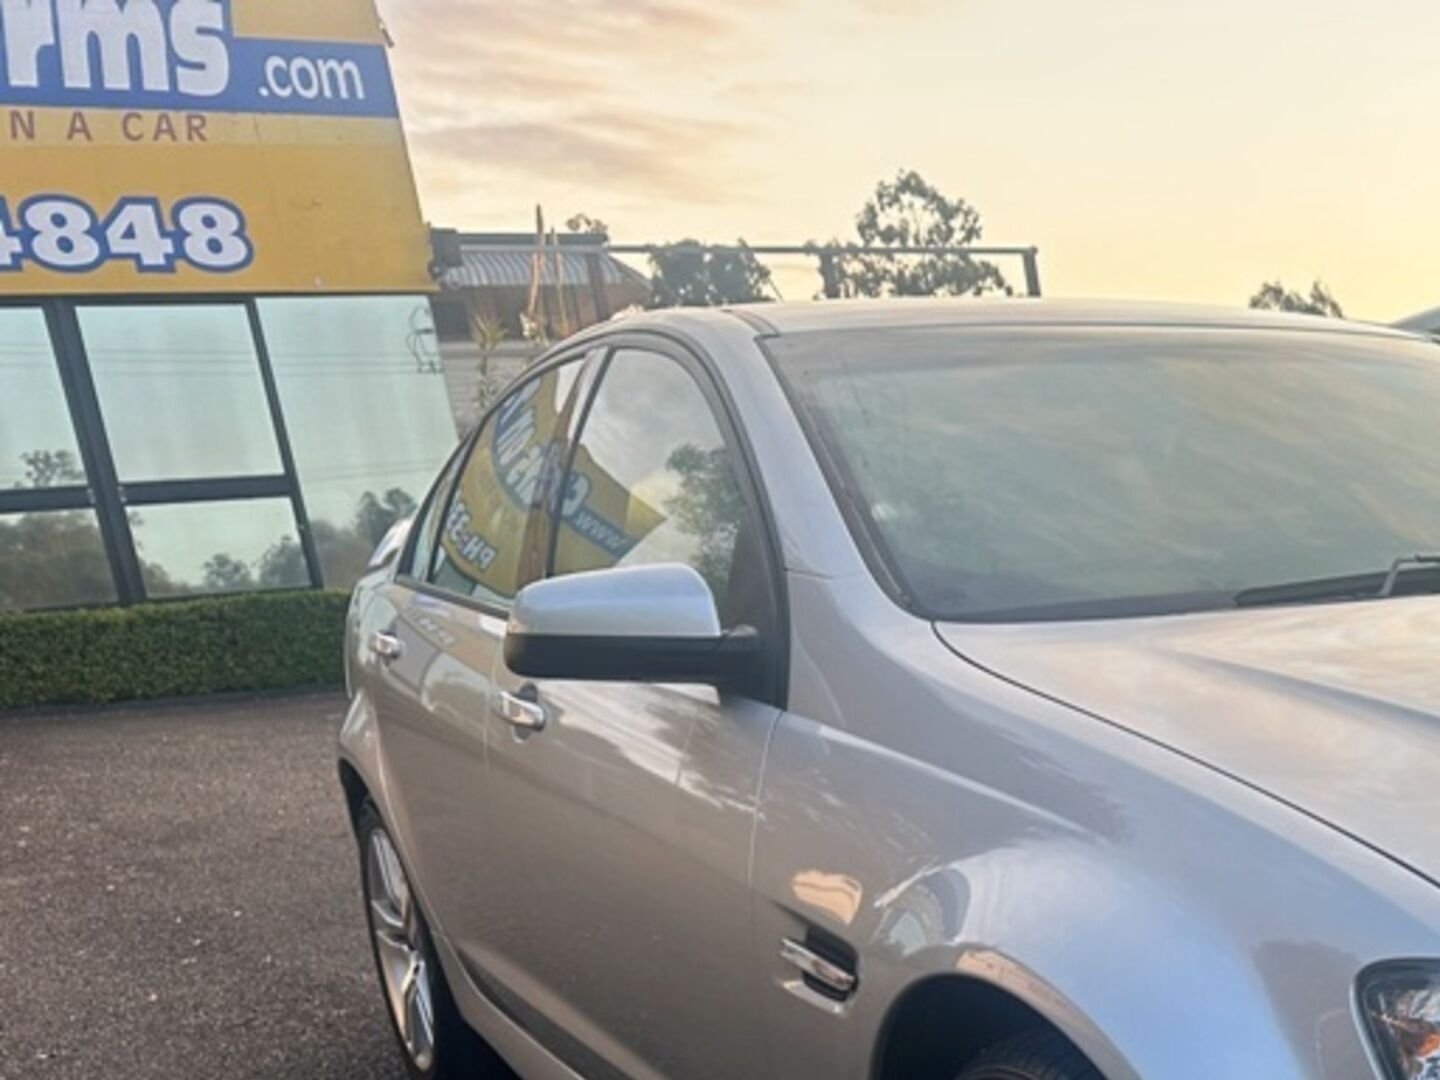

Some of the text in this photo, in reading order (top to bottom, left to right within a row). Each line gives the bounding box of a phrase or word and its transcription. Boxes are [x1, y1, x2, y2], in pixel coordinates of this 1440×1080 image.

[259, 56, 364, 99] .com
[66, 110, 93, 141] A
[121, 111, 208, 142] CAR
